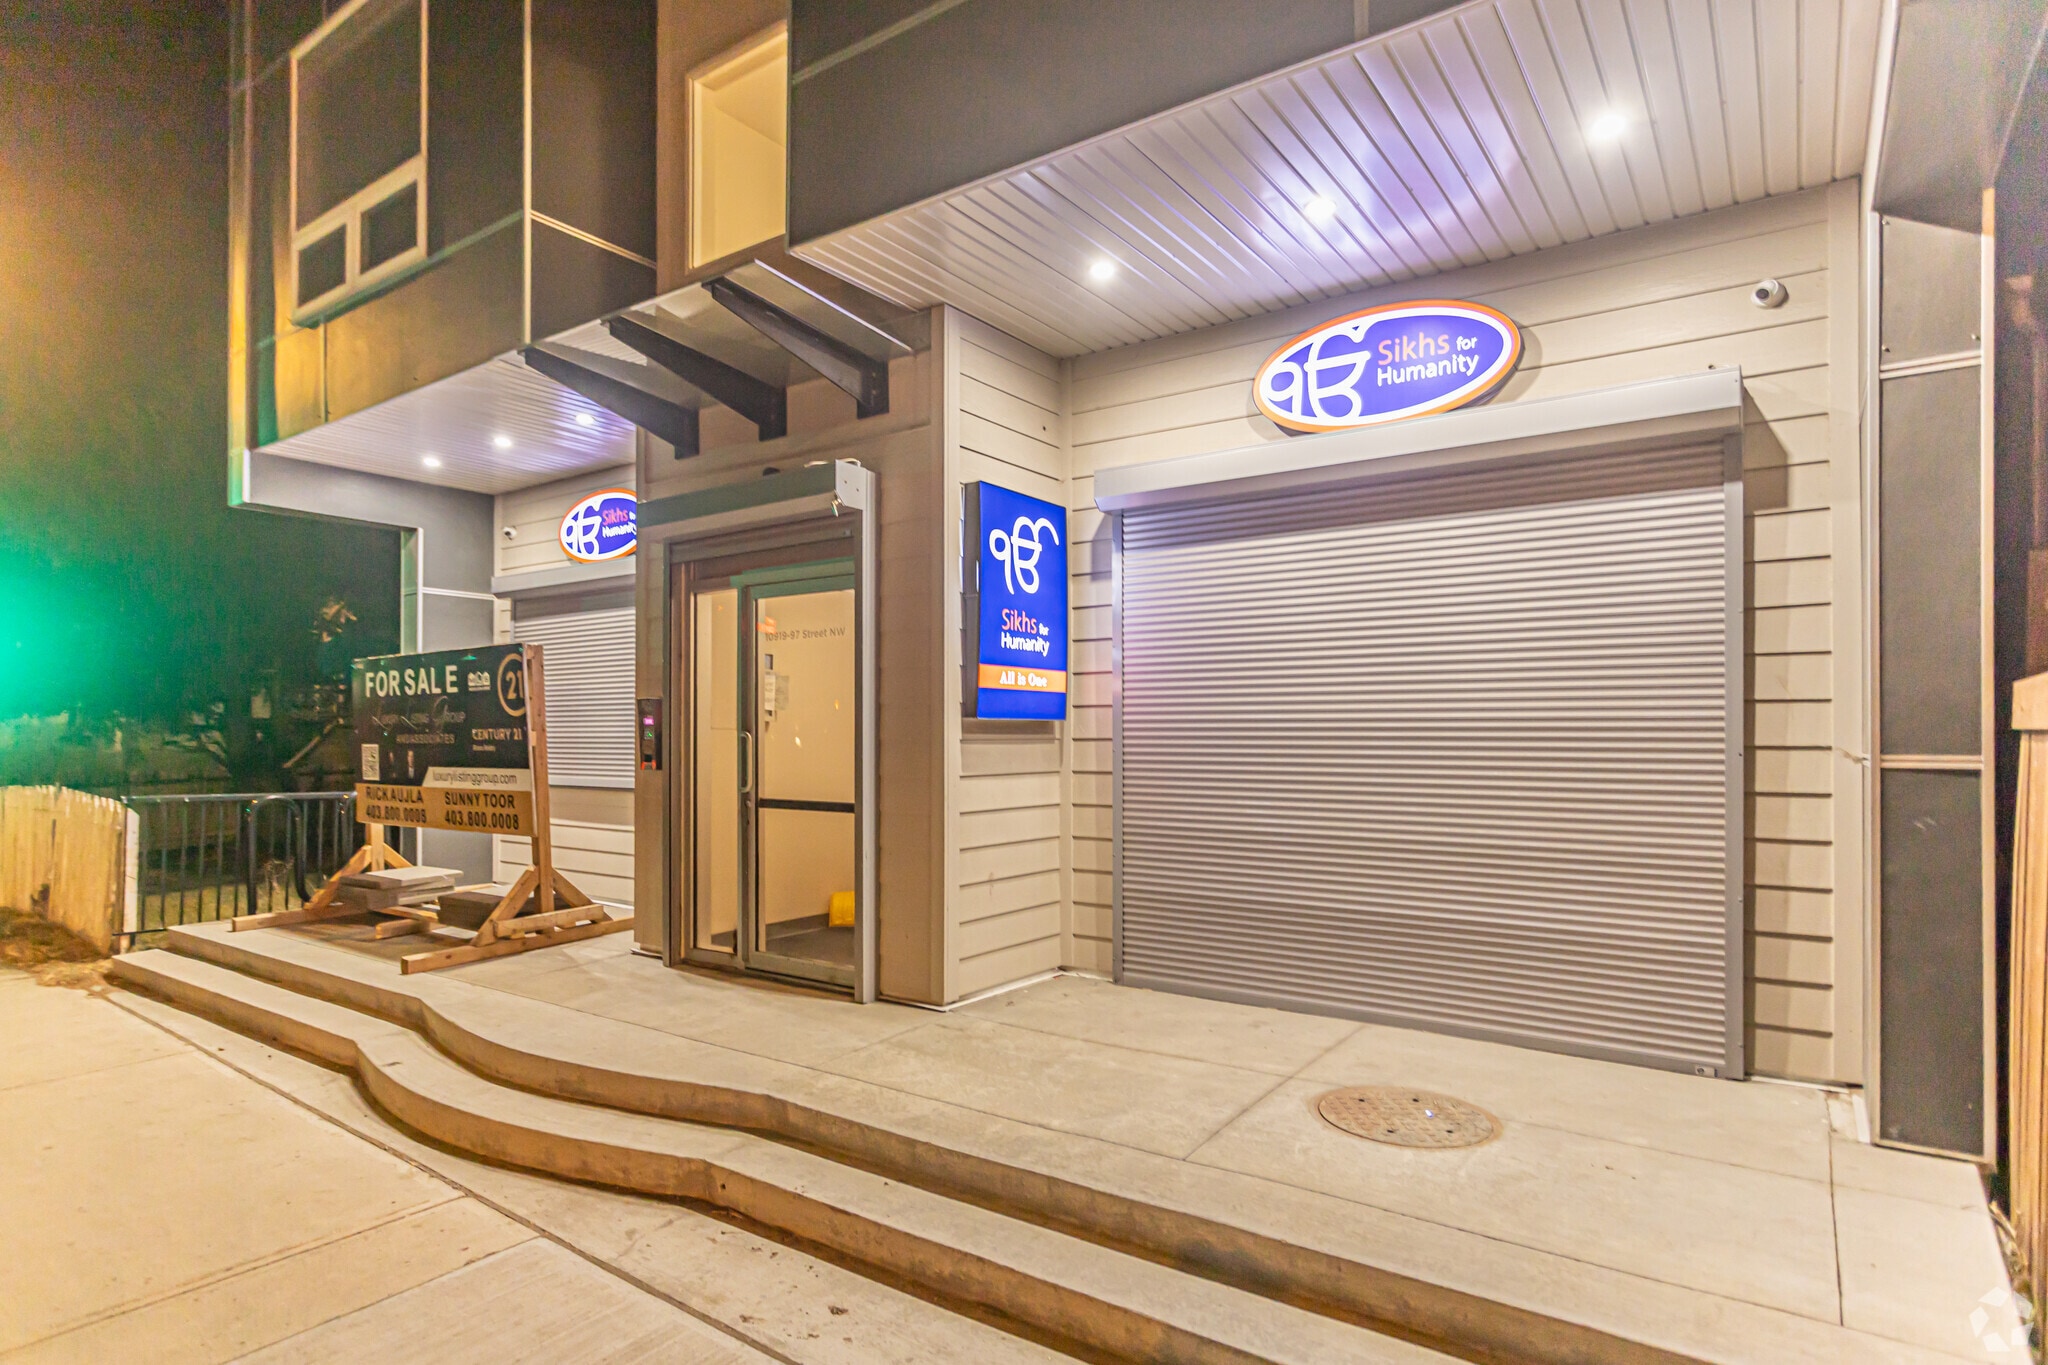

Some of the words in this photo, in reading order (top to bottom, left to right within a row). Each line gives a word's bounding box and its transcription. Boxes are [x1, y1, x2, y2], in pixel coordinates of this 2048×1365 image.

[1378, 331, 1450, 366] Sikhs
[1456, 336, 1478, 351] for
[1377, 353, 1480, 387] Humanity
[602, 507, 629, 526] Sikhs
[802, 628, 828, 640] Street
[829, 626, 846, 637] NW
[1001, 608, 1038, 634] Sikhs
[1038, 623, 1050, 636] for
[1001, 631, 1050, 657] Humanity
[365, 669, 401, 698] FOR
[404, 665, 459, 696] SALE
[505, 669, 524, 700] 21
[1000, 670, 1015, 685] All
[1017, 672, 1026, 686] is
[1027, 672, 1048, 688] One
[471, 728, 511, 741] CENTURY
[513, 727, 522, 741] 21
[445, 791, 481, 807] SUNNY
[483, 793, 516, 809] TOOR
